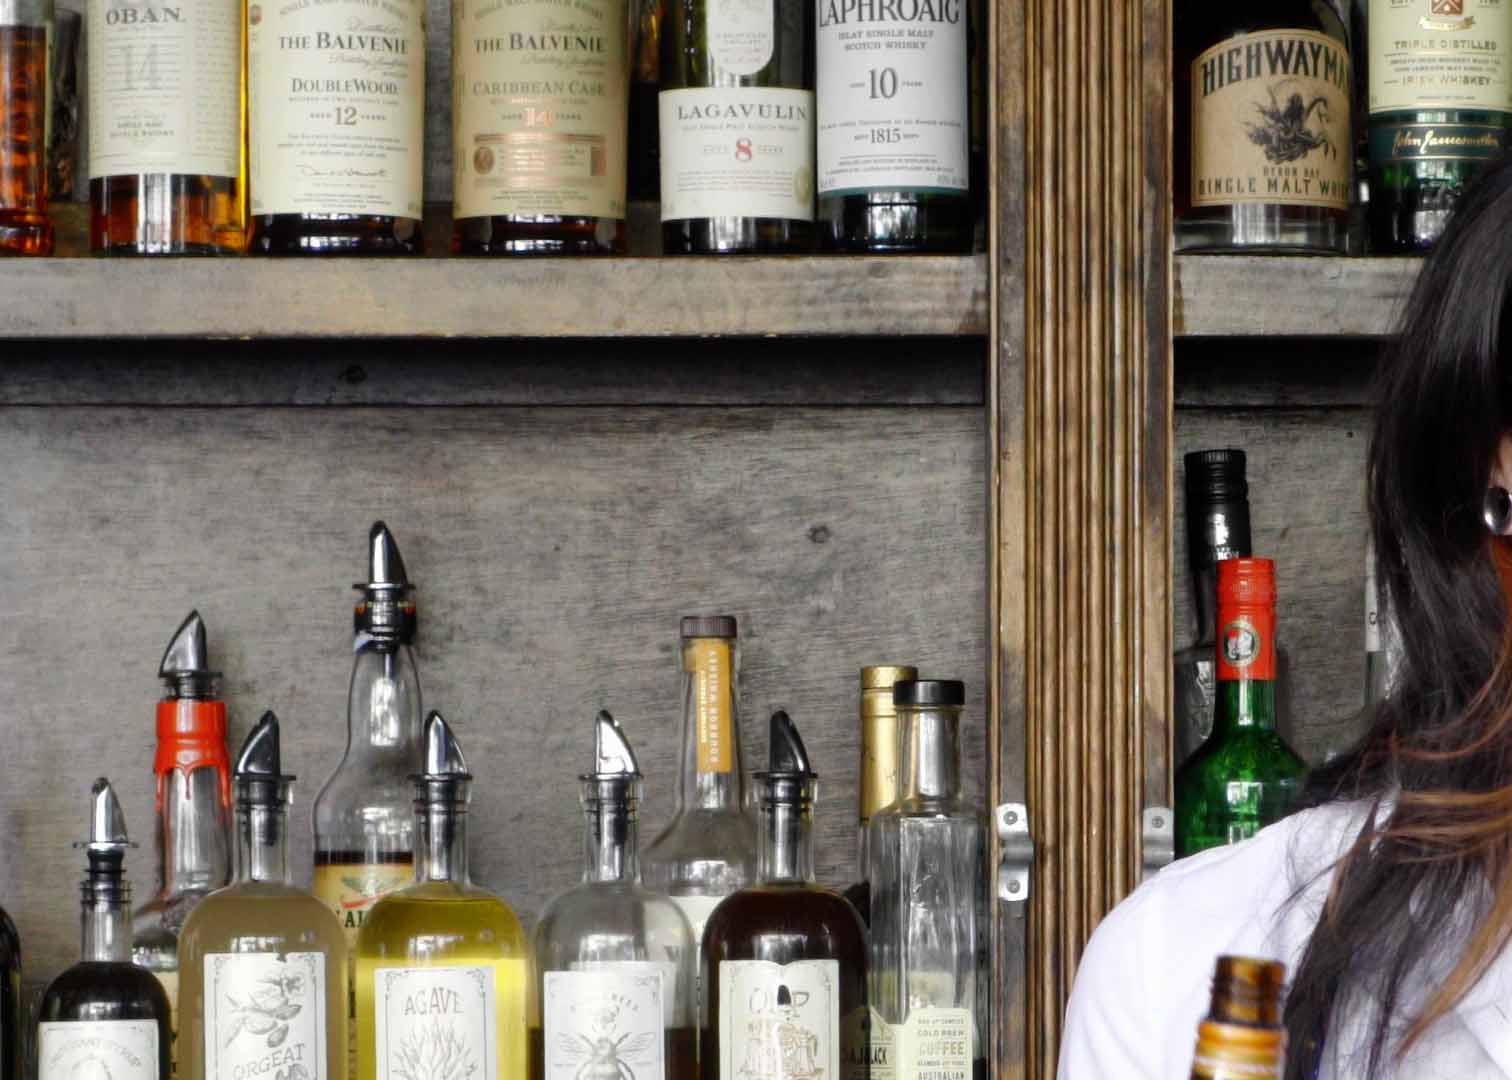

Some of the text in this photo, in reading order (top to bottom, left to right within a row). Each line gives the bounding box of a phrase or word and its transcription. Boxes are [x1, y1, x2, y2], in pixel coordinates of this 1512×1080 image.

[106, 7, 182, 25] OBAN
[818, 0, 960, 27] LAPHROAIG
[280, 35, 312, 50] THE
[473, 38, 505, 53] THE
[291, 77, 400, 97] DOUBLEWOOD
[472, 79, 565, 97] CARIBBEAN
[868, 66, 899, 100] 10
[334, 106, 359, 126] 12
[525, 106, 553, 128] 14
[676, 103, 809, 121] LAGAVULIN
[870, 127, 901, 144] 1815
[734, 136, 753, 163] 8
[1199, 177, 1257, 196] SINGLE
[1266, 179, 1312, 195] MALT
[403, 986, 466, 1017] AGAVE
[866, 1045, 888, 1066] LACK
